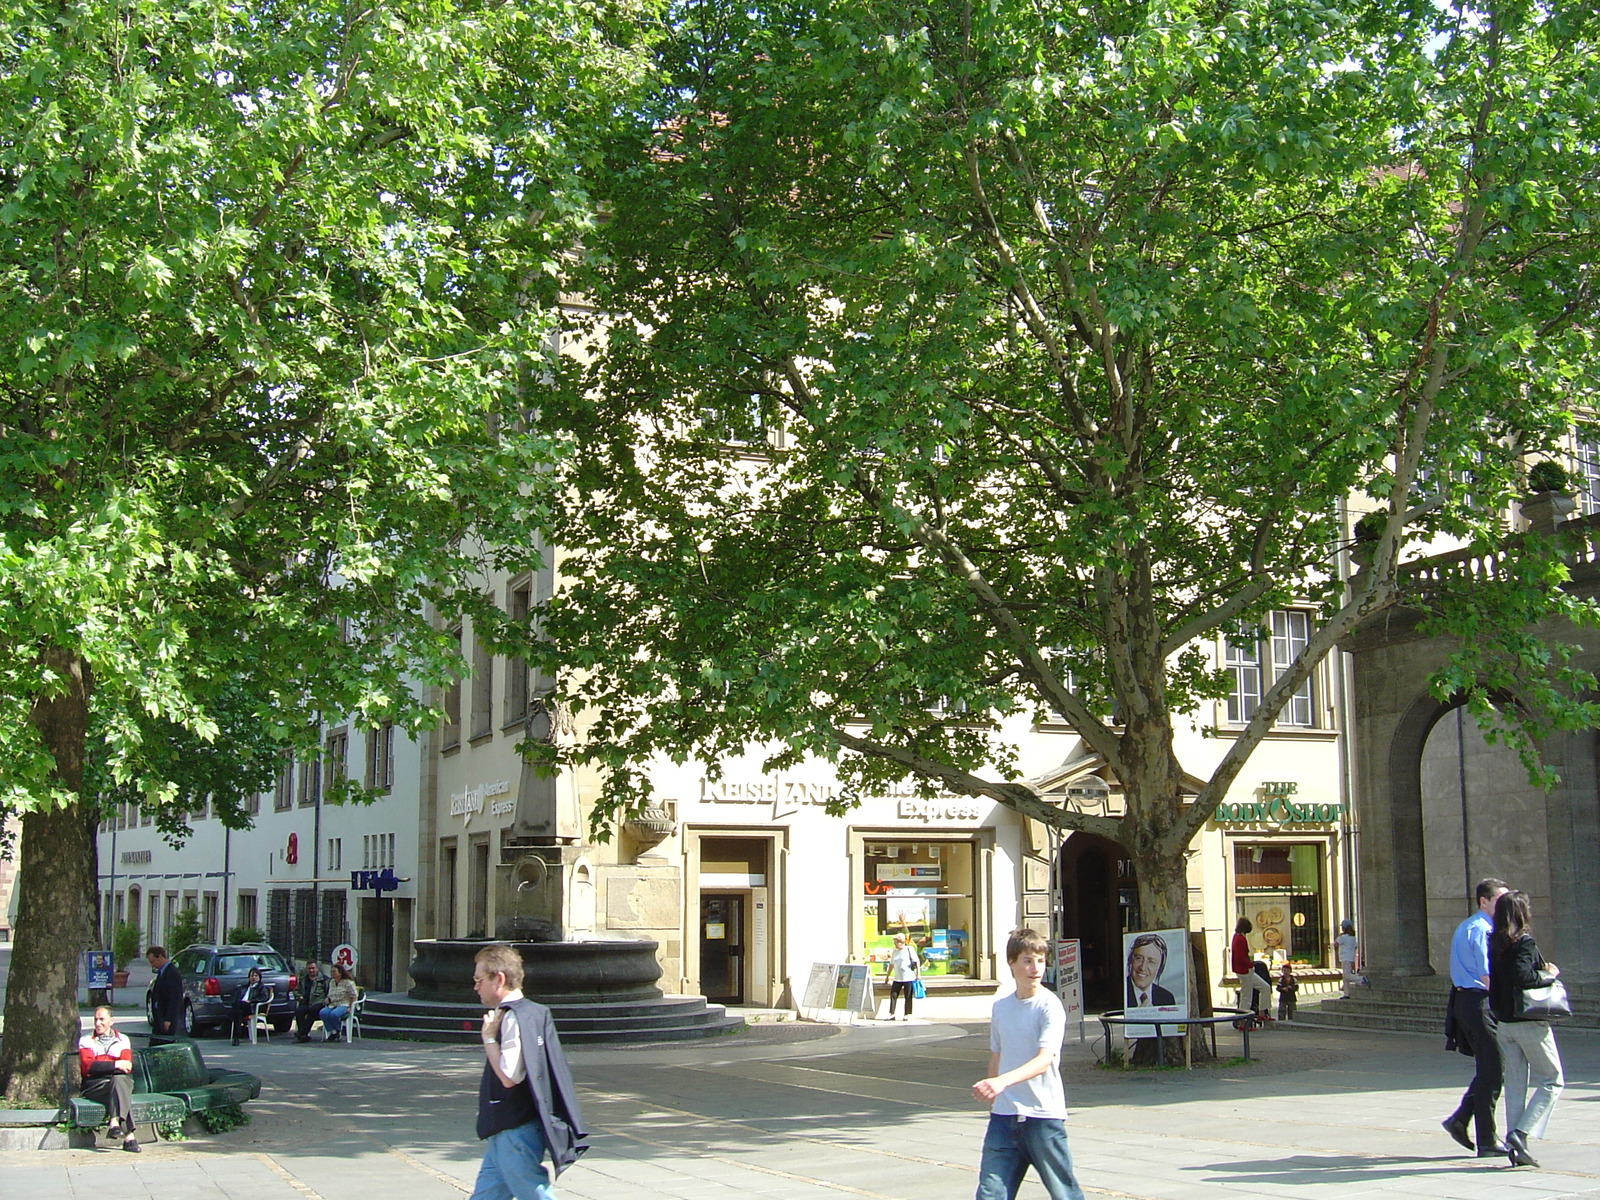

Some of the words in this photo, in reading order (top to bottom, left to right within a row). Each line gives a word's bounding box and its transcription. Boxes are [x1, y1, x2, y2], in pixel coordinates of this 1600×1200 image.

[1262, 781, 1298, 795] THE
[898, 798, 980, 824] Express
[1215, 802, 1268, 823] BODY
[1291, 802, 1345, 823] SHOP
[337, 947, 354, 967] A
